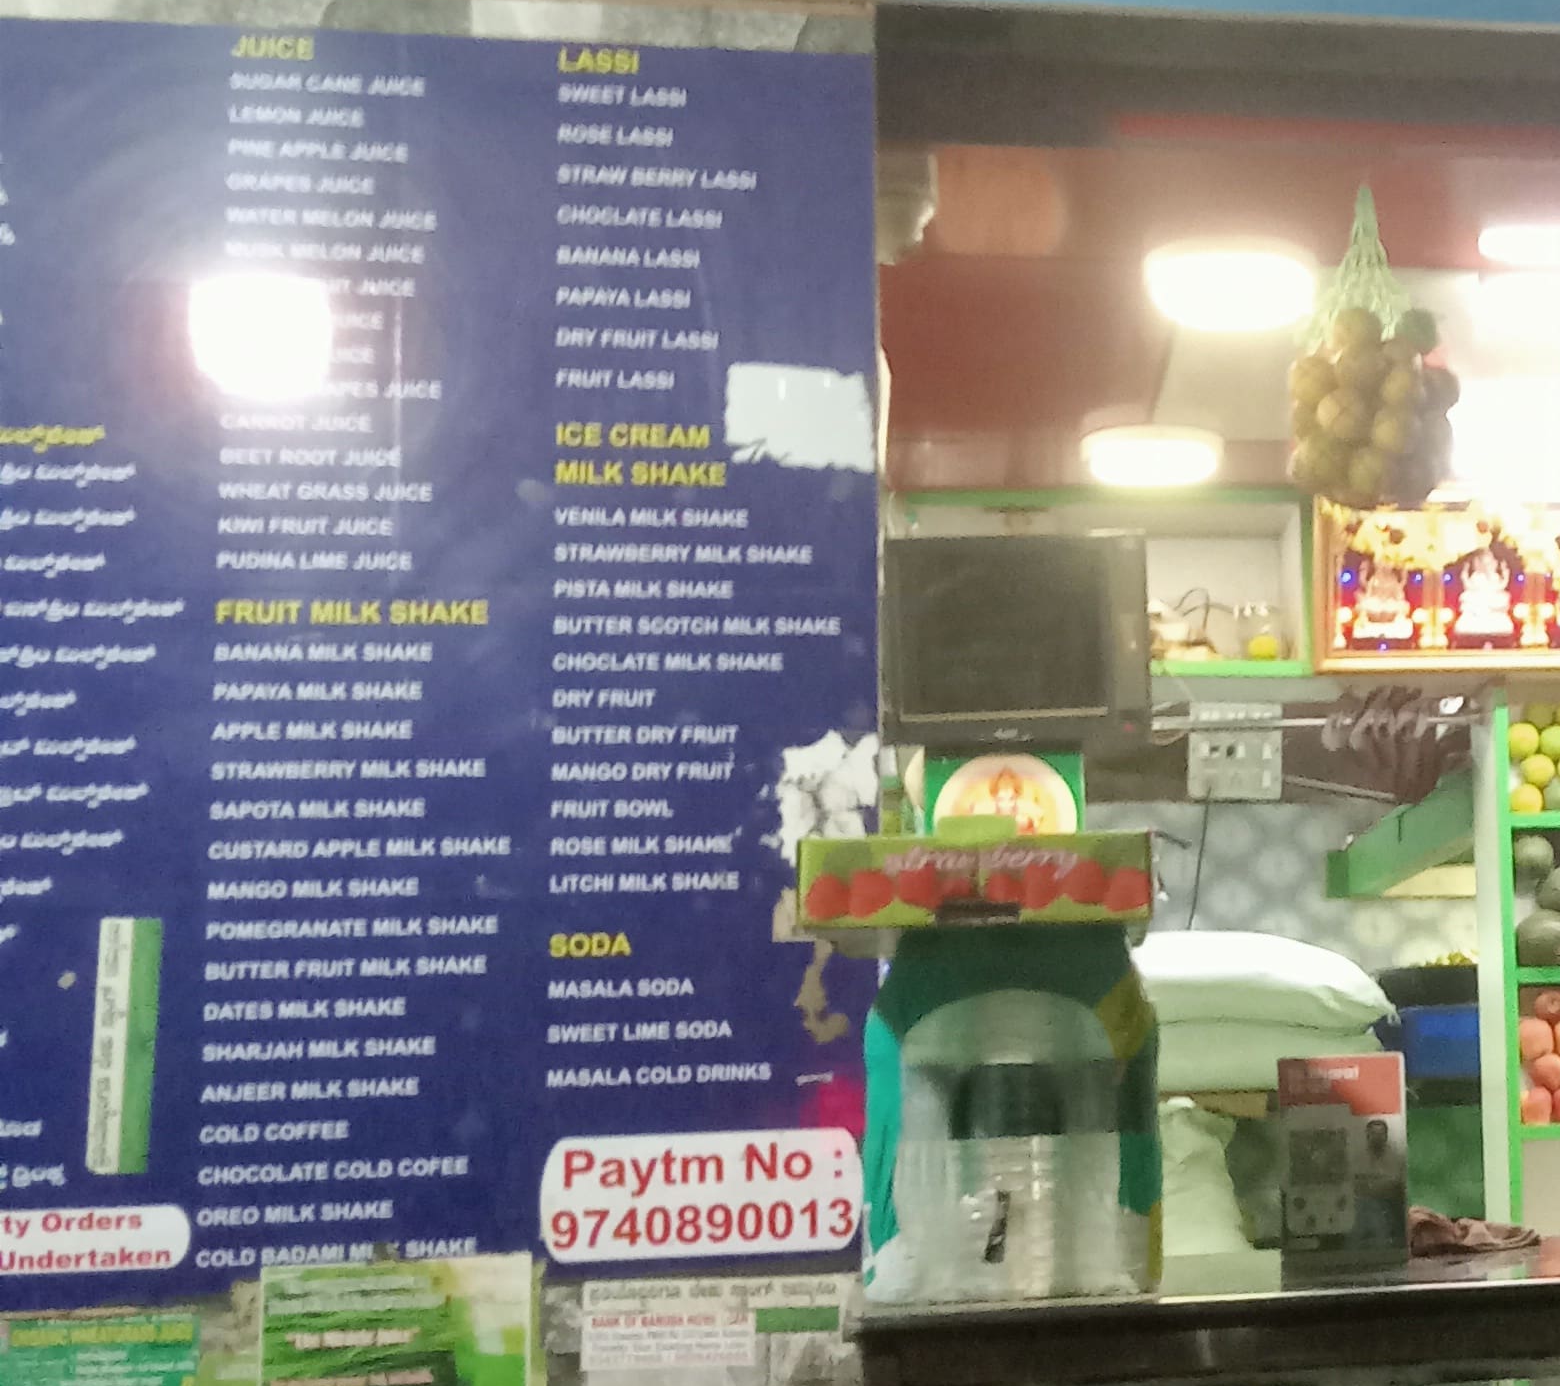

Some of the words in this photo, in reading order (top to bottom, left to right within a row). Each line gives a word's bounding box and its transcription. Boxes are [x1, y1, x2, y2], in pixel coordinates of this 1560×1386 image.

[232, 35, 313, 60] JUICE
[558, 48, 638, 74] LASSI
[368, 75, 425, 97] JUICE
[557, 164, 627, 185] STRAW
[701, 170, 756, 190] LASSI
[557, 205, 661, 226] CHOCLATE
[666, 209, 722, 229] LASSI
[557, 246, 640, 266] BANANA
[644, 249, 700, 268] LASSI
[556, 286, 630, 306] PAPAYA
[634, 289, 690, 309] LASSI
[556, 327, 596, 347] DRY
[601, 329, 657, 349] FRUIT
[662, 331, 718, 350] LASSI
[556, 369, 612, 387] FRUIT
[618, 371, 675, 389] LASSI
[312, 413, 372, 433] JUICE
[556, 423, 601, 447] ICE
[609, 424, 710, 448] CREAM
[279, 445, 337, 465] ROOT
[343, 448, 401, 467] JUICE
[556, 461, 623, 485] MILK
[631, 462, 726, 486] SHAKE
[218, 481, 292, 500] WHEAT
[296, 482, 368, 501] GRASS
[374, 482, 432, 502] JUICE
[217, 517, 264, 534] KIWI
[268, 517, 328, 534] FRUIT
[333, 517, 392, 535] JUICE
[555, 507, 625, 526] VENILA
[630, 509, 676, 526] MILK
[682, 508, 748, 527] SHAKE
[216, 551, 296, 569] PUDINA
[299, 552, 347, 570] LIME
[353, 552, 411, 570] JUICE
[555, 543, 691, 562] STRAWBERRY
[695, 545, 742, 563] MILK
[747, 546, 812, 563] SHAKE
[554, 579, 610, 598] PISTA
[614, 581, 661, 598] MILK
[666, 581, 733, 599] SHAKE
[215, 599, 301, 624] FRUIT
[310, 601, 381, 624] MILK
[390, 600, 488, 624] SHAKE
[553, 616, 632, 635] BUTTER
[637, 616, 718, 635] SCOTCH
[723, 617, 769, 635] MILK
[774, 617, 840, 635] SHAKE
[214, 643, 303, 662] BANANA
[308, 643, 357, 661] MILK
[363, 643, 432, 661] SHAKE
[552, 653, 658, 671] CHOCLATE
[664, 653, 711, 670] MILK
[716, 653, 782, 671] SHAKE
[213, 683, 292, 700] PAPAYA
[296, 683, 346, 700] MILK
[352, 681, 421, 699] SHAKE
[553, 689, 594, 707] DRY
[598, 689, 655, 707] FRUIT
[211, 722, 280, 741] APPLE
[285, 721, 336, 740] MILK
[341, 720, 412, 740] SHAKE
[552, 726, 631, 744] BUTTER
[636, 725, 677, 744] DRY
[681, 725, 738, 743] FRUIT
[212, 760, 356, 780] STRAWBERRY
[360, 760, 411, 778] MILK
[416, 759, 485, 777] SHAKE
[552, 763, 627, 781] MANGO
[632, 762, 672, 781] DRY
[677, 762, 734, 779] FRUIT
[210, 800, 294, 819] SAPOTA
[298, 800, 349, 818] MILK
[354, 799, 424, 818] SHAKE
[551, 799, 608, 818] FRUIT
[614, 799, 673, 817] BOWL
[208, 840, 308, 860] CUSTARD
[312, 838, 380, 858] APPLE
[386, 839, 435, 856] MILK
[440, 836, 510, 855] SHAKE
[551, 837, 606, 856] ROSE
[611, 837, 660, 855] MILK
[665, 835, 733, 854] SHAKE
[207, 881, 288, 900] MANGO
[292, 880, 342, 898] MILK
[348, 878, 418, 897] SHAKE
[550, 874, 614, 893] LITCHI
[618, 873, 666, 892] MILK
[672, 872, 739, 891] SHAKE
[206, 919, 366, 940] POMEGRANATE
[372, 917, 422, 936] MILK
[427, 916, 497, 935] SHAKE
[549, 932, 631, 958] SODA
[205, 960, 289, 981] BUTTER
[294, 958, 355, 978] FRUIT
[360, 958, 410, 976] MILK
[415, 955, 486, 974] SHAKE
[548, 980, 633, 999] MASALA
[637, 978, 693, 996] SODA
[204, 1001, 273, 1021] DATES
[278, 1000, 328, 1018] MILK
[334, 998, 405, 1017] SHAKE
[548, 1023, 619, 1043] SWEET
[623, 1021, 670, 1040] LIME
[676, 1020, 732, 1039] SODA
[203, 1041, 303, 1062] SHARJAH
[308, 1039, 359, 1058] MILK
[364, 1036, 435, 1057] SHAKE
[547, 1068, 631, 1087] MASALA
[636, 1065, 692, 1084] COLD
[697, 1063, 771, 1083] DRINKS
[201, 1082, 286, 1103] ANJEER
[291, 1080, 342, 1100] MILK
[347, 1077, 419, 1097] SHAKE
[199, 1123, 260, 1144] COLD
[264, 1121, 349, 1141] COFFEE
[198, 1162, 328, 1185] CHOCOLATE
[334, 1159, 393, 1180] COLD
[397, 1155, 468, 1177] COFEE
[562, 1146, 724, 1197] Paytm
[743, 1142, 813, 1183] No
[196, 1206, 260, 1226] OREO
[264, 1205, 314, 1223] MILK
[320, 1200, 392, 1220] SHAKE
[551, 1198, 854, 1250] 9740890013
[0, 1215, 30, 1238] ty
[42, 1211, 143, 1233] Orders
[0, 1247, 171, 1271] Undertaken
[195, 1247, 255, 1268] COLD
[406, 1238, 475, 1258] SHAKE
